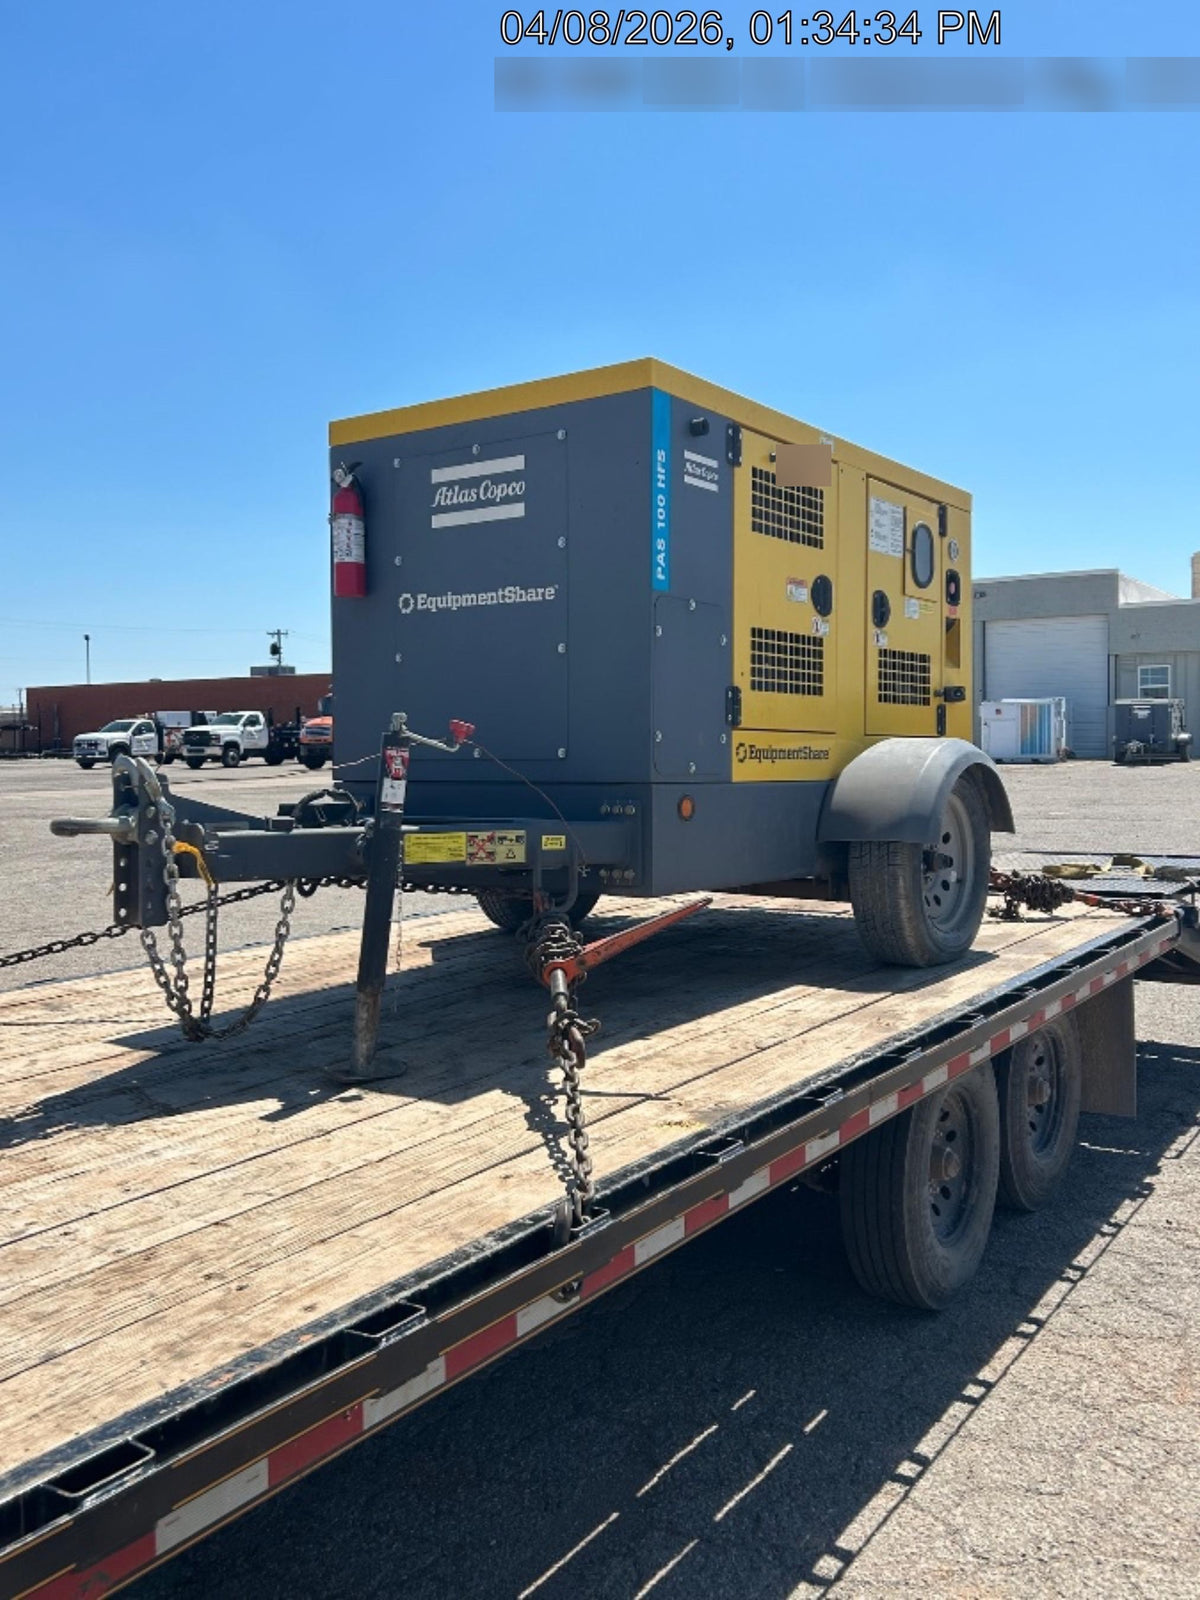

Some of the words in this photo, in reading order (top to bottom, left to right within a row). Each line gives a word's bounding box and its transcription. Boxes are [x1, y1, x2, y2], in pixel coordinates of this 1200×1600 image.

[657, 449, 666, 488] HFS
[430, 485, 477, 507] Atlas
[479, 479, 526, 502] Copco
[657, 494, 666, 528] 100
[656, 538, 666, 580] PAS
[416, 585, 556, 612] EquipmentShare
